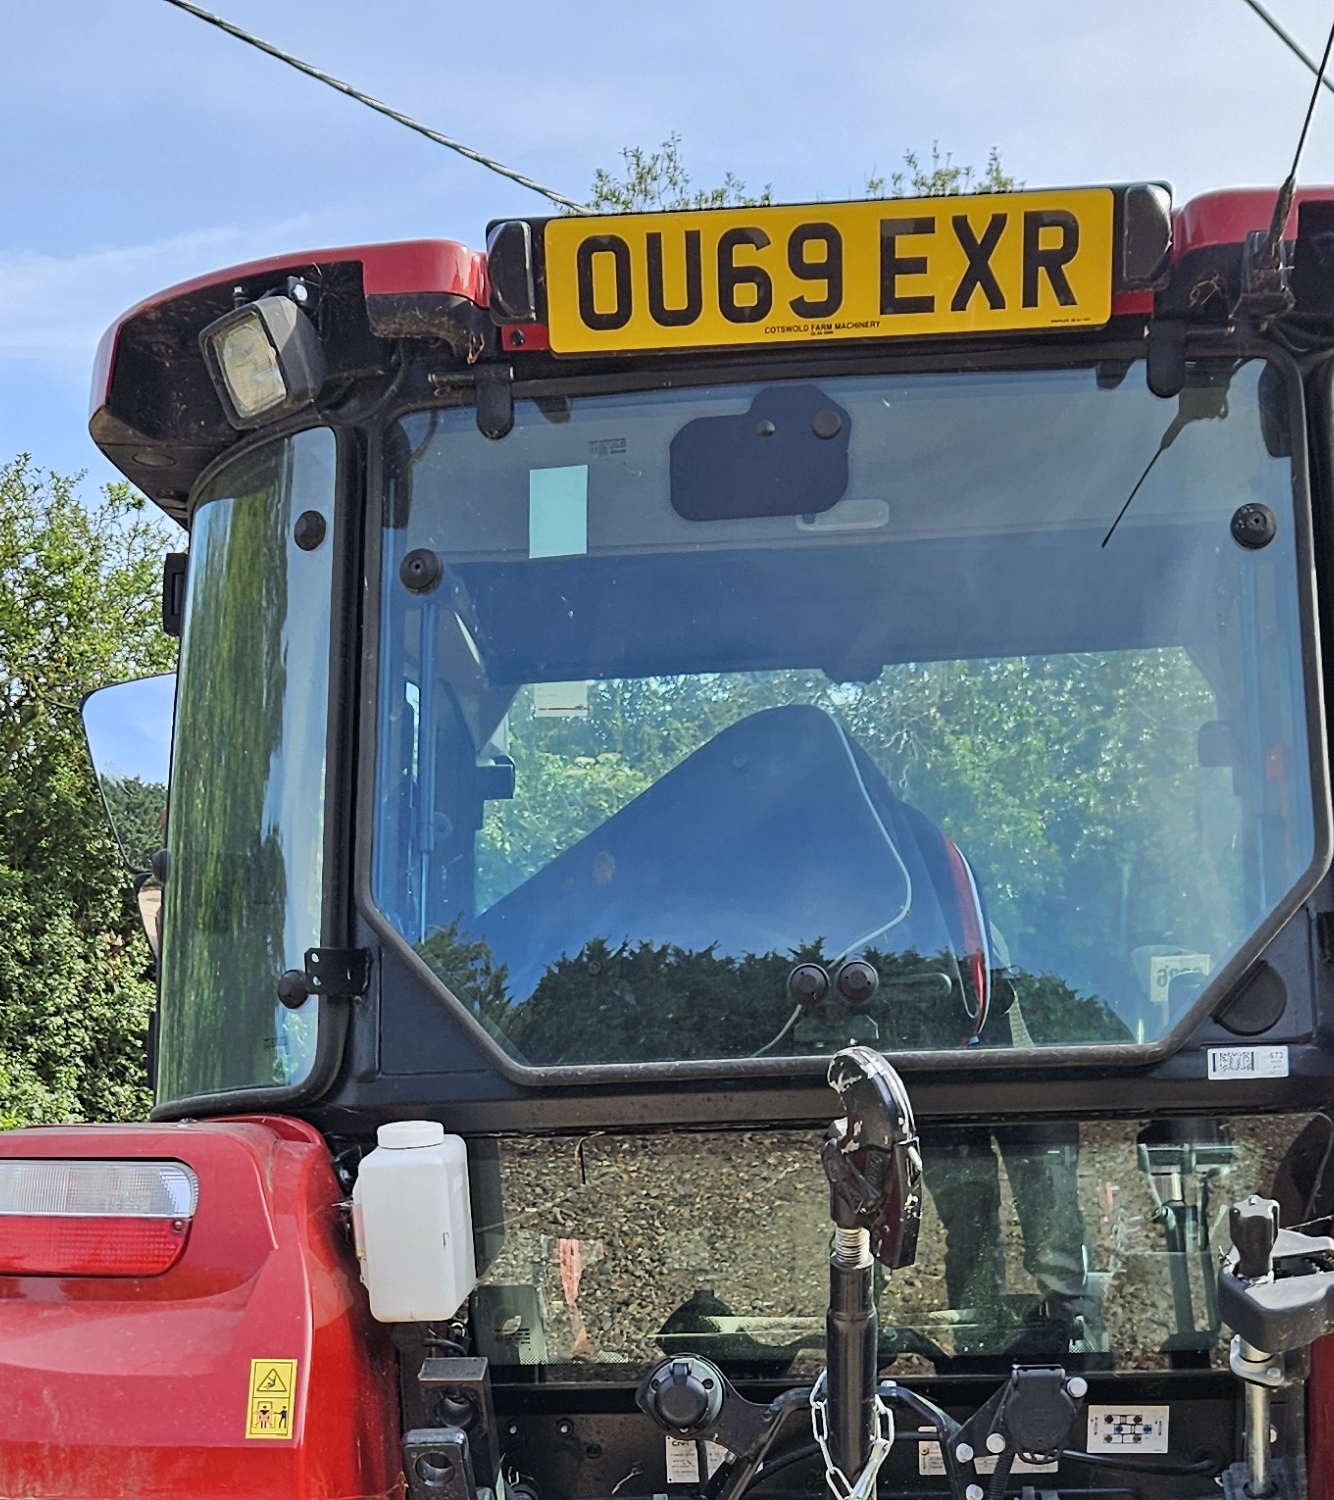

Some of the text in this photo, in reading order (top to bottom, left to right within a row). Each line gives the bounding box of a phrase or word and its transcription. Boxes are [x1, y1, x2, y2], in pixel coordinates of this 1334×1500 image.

[577, 209, 1079, 331] OU69 EXR
[764, 324, 809, 334] COTSWOLD
[811, 322, 833, 331] FARM
[835, 320, 881, 330] MACHINERY
[1269, 1051, 1284, 1059] 673
